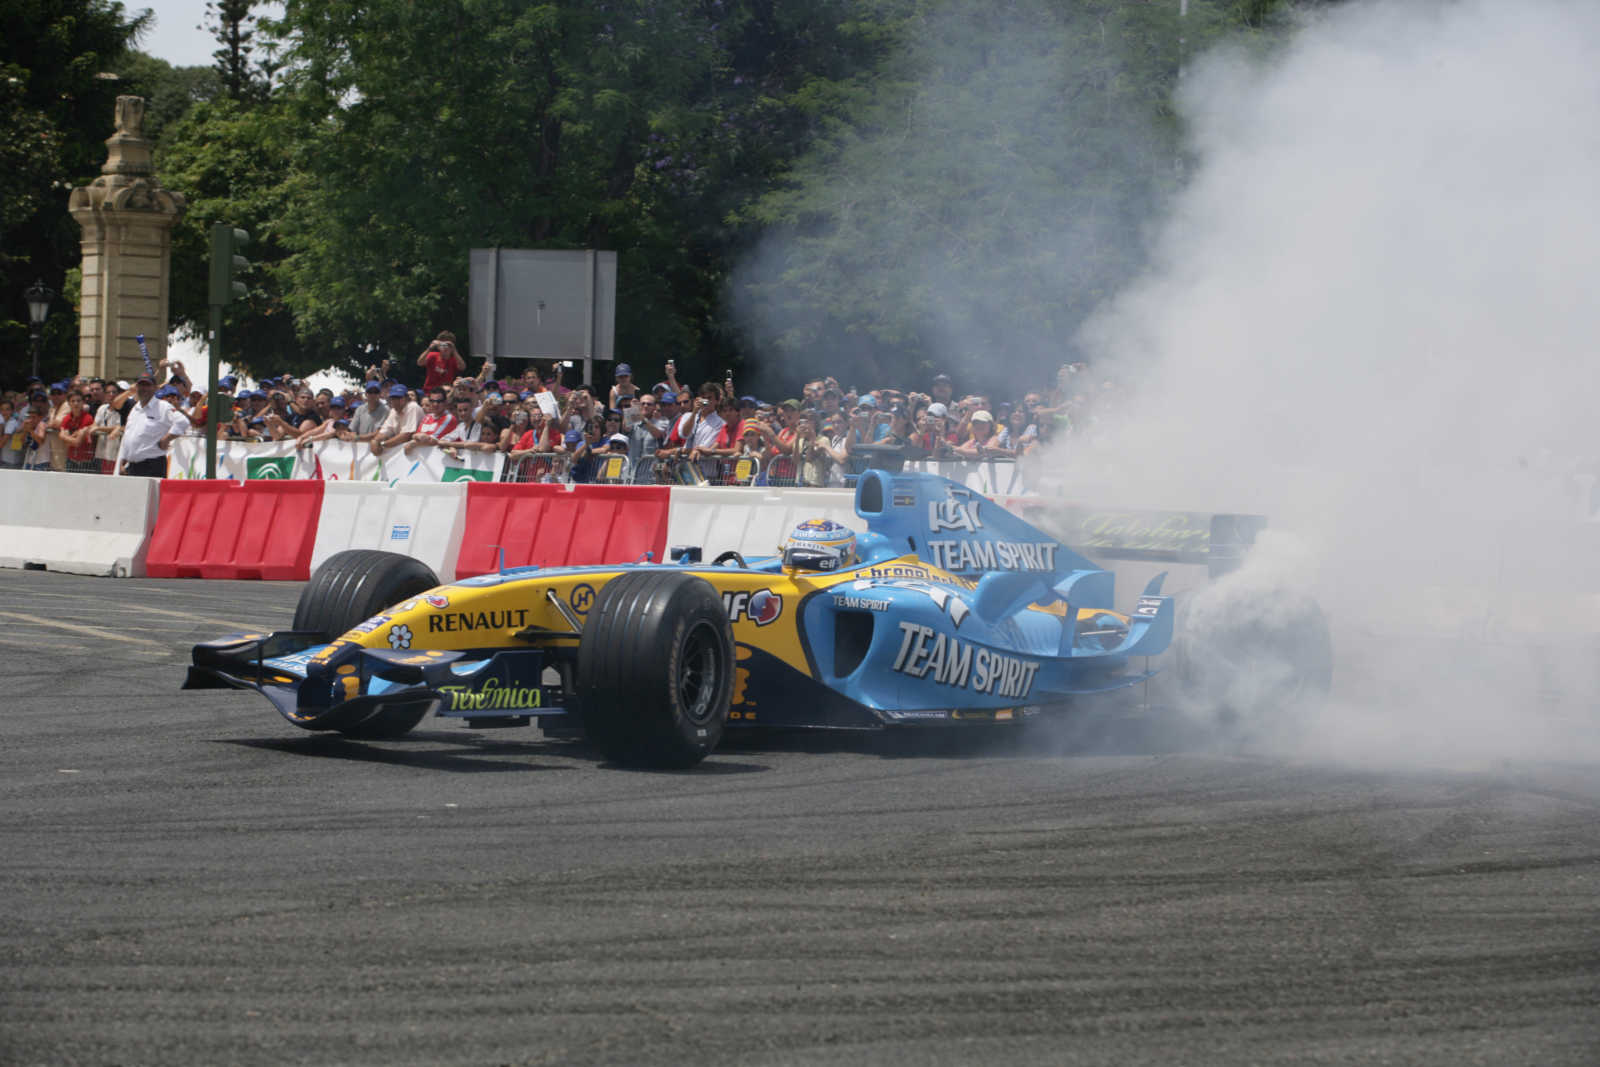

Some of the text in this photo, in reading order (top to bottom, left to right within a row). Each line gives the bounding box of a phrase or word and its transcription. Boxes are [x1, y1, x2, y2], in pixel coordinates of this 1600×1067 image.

[819, 559, 836, 570] elf
[930, 539, 1057, 570] TEAM SPIRIT
[833, 596, 889, 610] TEAM SPIRIT
[429, 610, 528, 632] RENAULT
[893, 621, 1040, 698] TEAM SPIRIT
